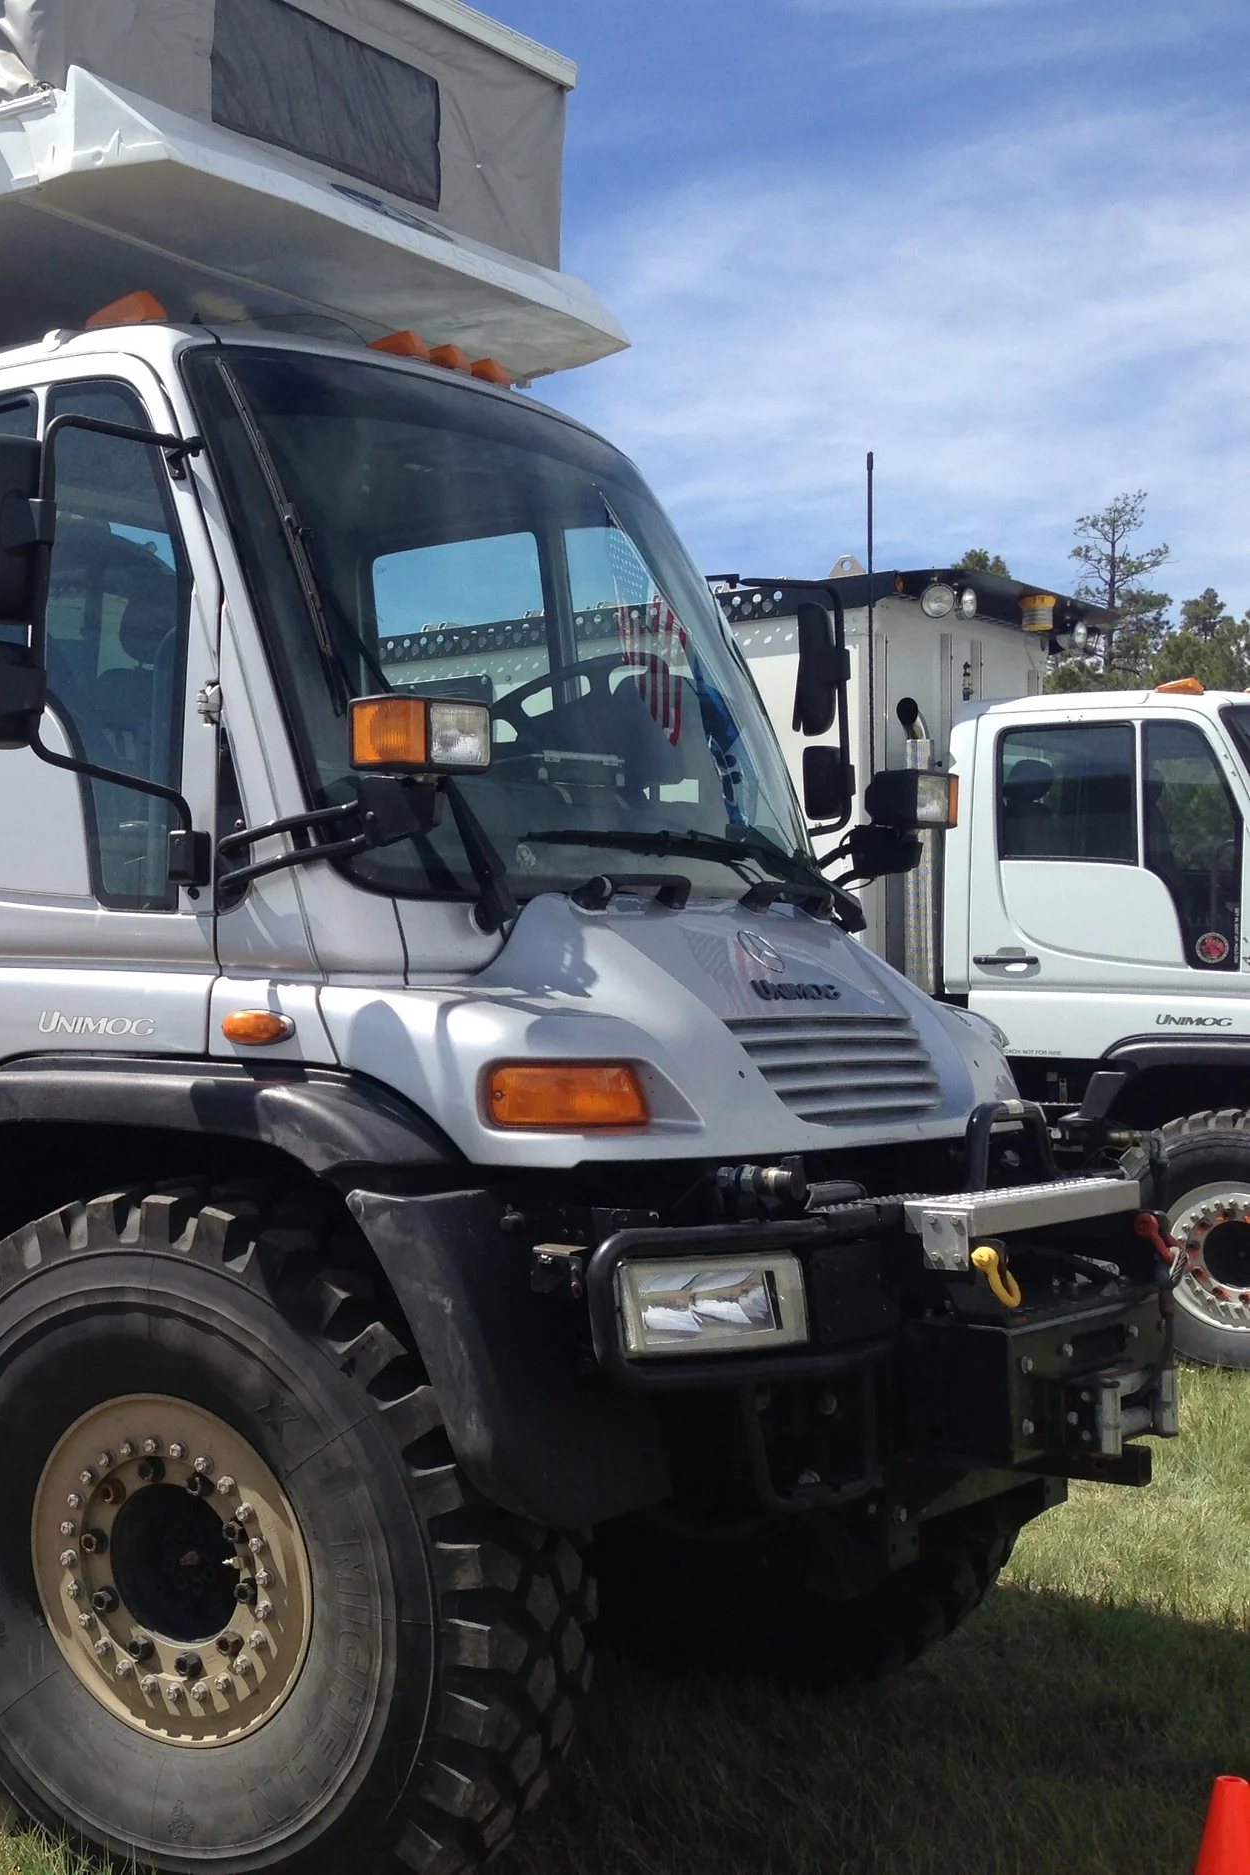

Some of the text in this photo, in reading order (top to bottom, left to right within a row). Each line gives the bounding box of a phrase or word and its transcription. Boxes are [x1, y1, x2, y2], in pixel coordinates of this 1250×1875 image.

[750, 979, 841, 1001] UNIMOG
[38, 1010, 156, 1036] UNIMOG
[1155, 1014, 1233, 1027] UNIMOG
[248, 1540, 372, 1833] MICHELIN
